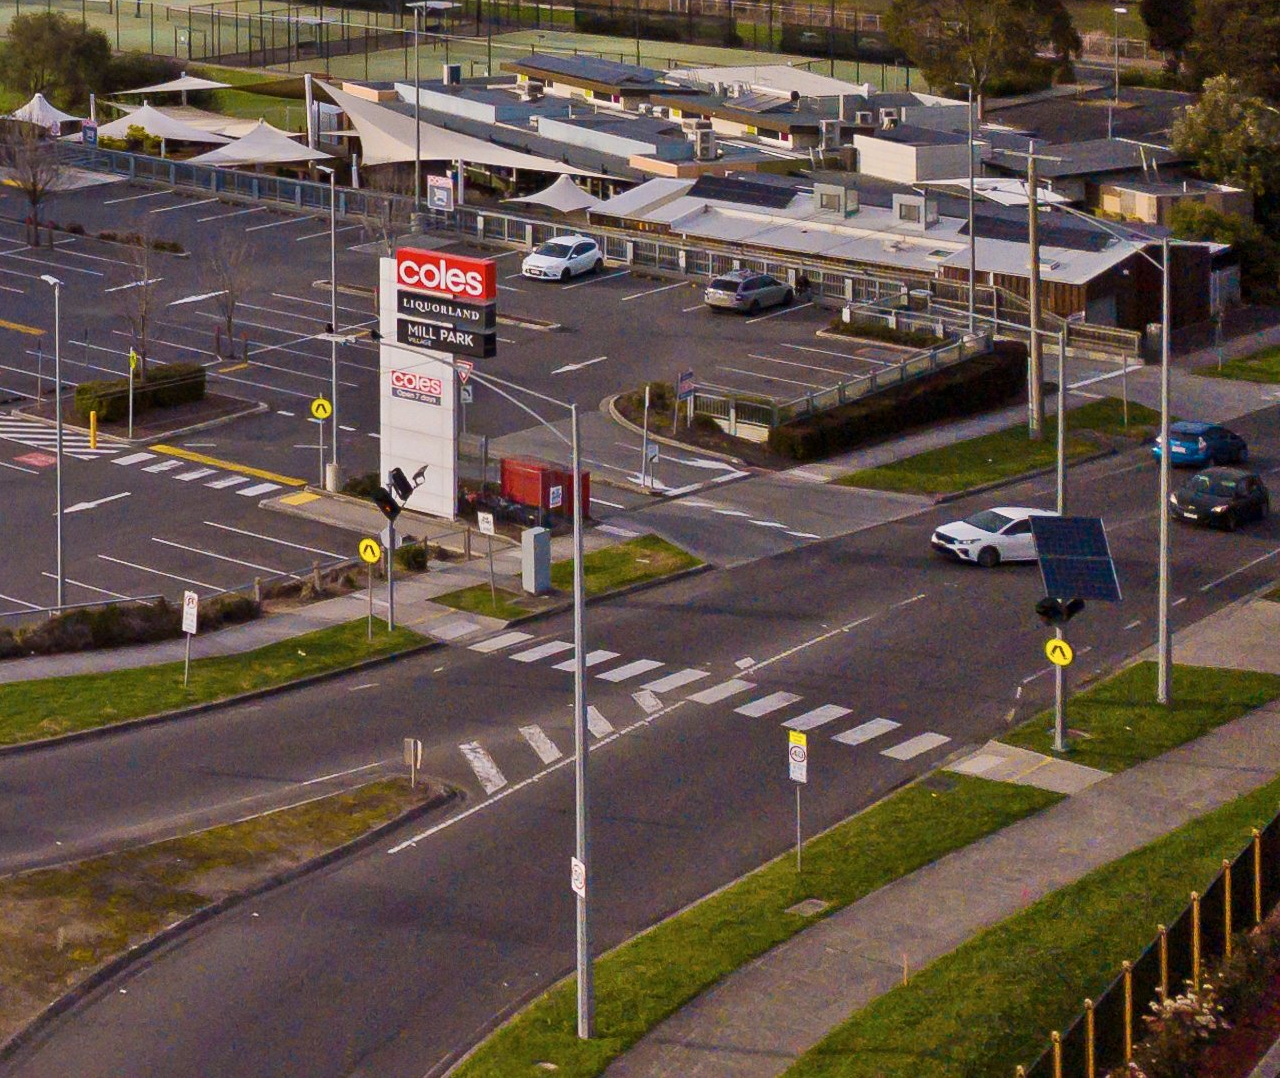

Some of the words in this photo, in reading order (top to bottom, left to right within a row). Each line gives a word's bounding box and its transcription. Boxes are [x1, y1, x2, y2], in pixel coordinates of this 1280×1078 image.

[399, 260, 483, 296] coles
[403, 298, 480, 321] LIQUORLAND
[408, 323, 437, 340] MILL
[440, 329, 474, 347] PARK
[392, 372, 442, 395] coles
